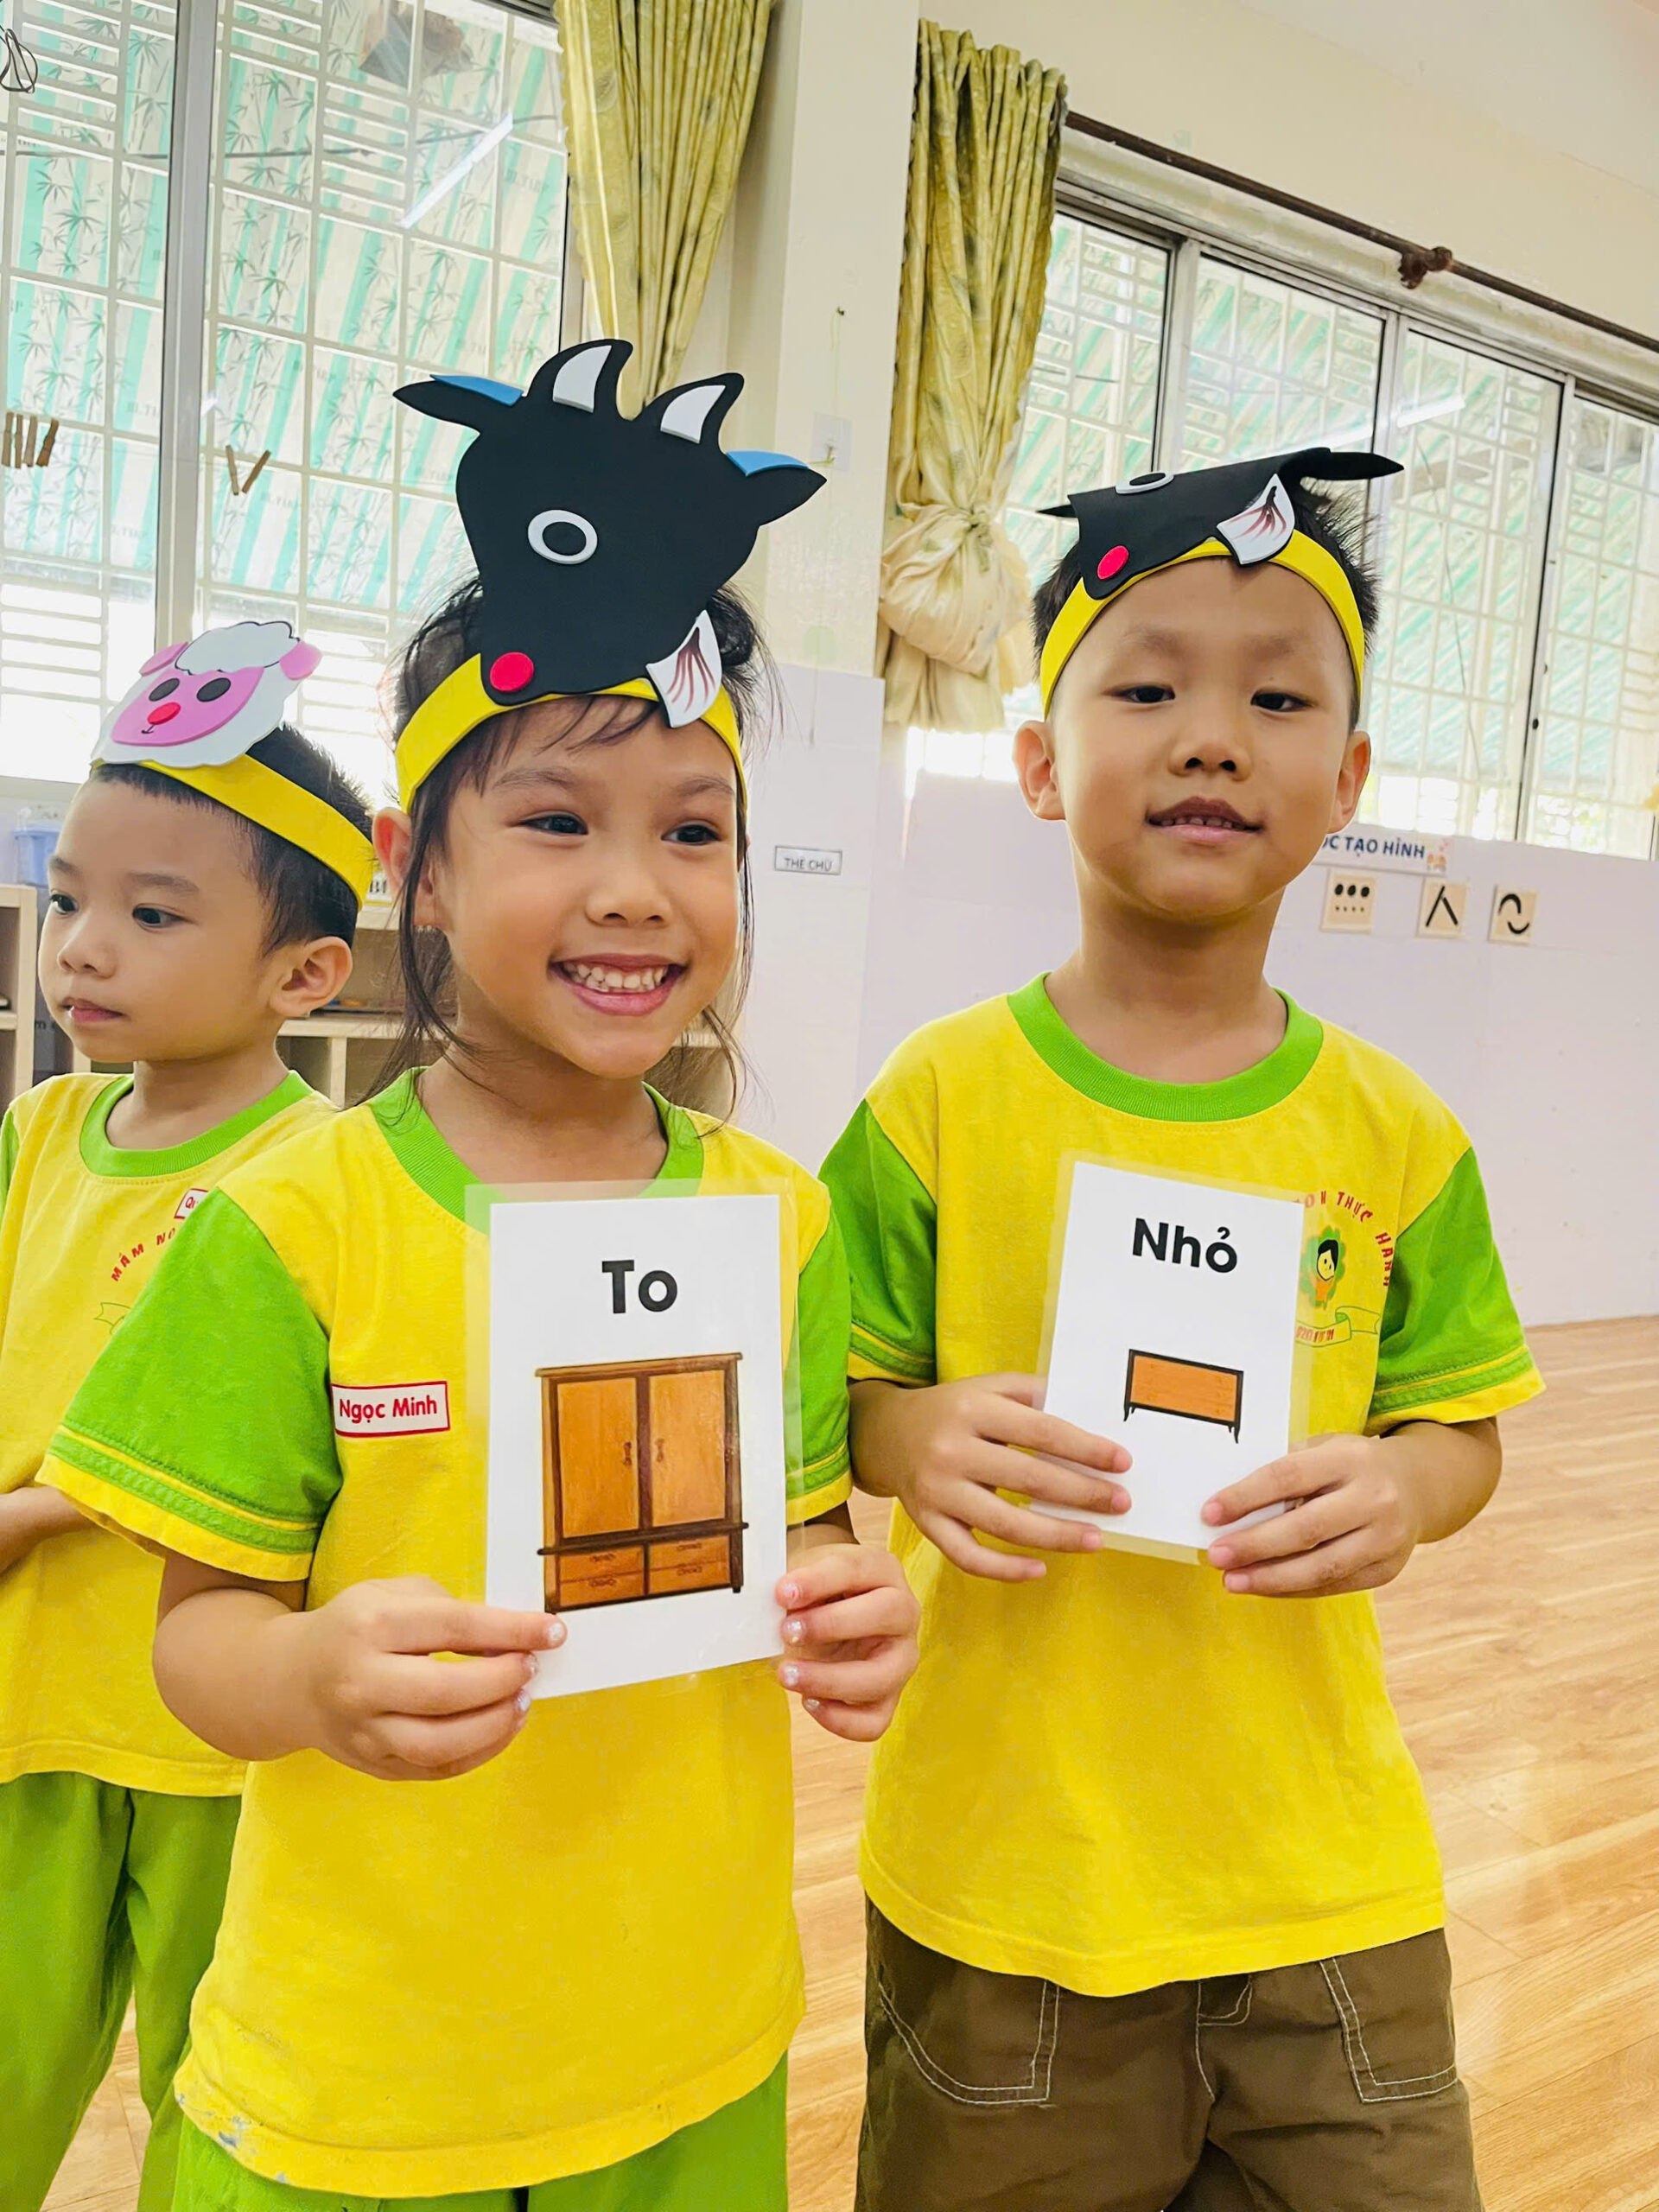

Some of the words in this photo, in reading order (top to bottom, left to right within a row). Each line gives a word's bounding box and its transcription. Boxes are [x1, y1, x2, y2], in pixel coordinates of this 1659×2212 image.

[1345, 836, 1378, 857] TẠO
[1132, 1217, 1237, 1273] Nhỏ
[601, 1259, 677, 1314] To
[339, 1398, 386, 1424] Ngọc
[392, 1395, 437, 1417] Minh
